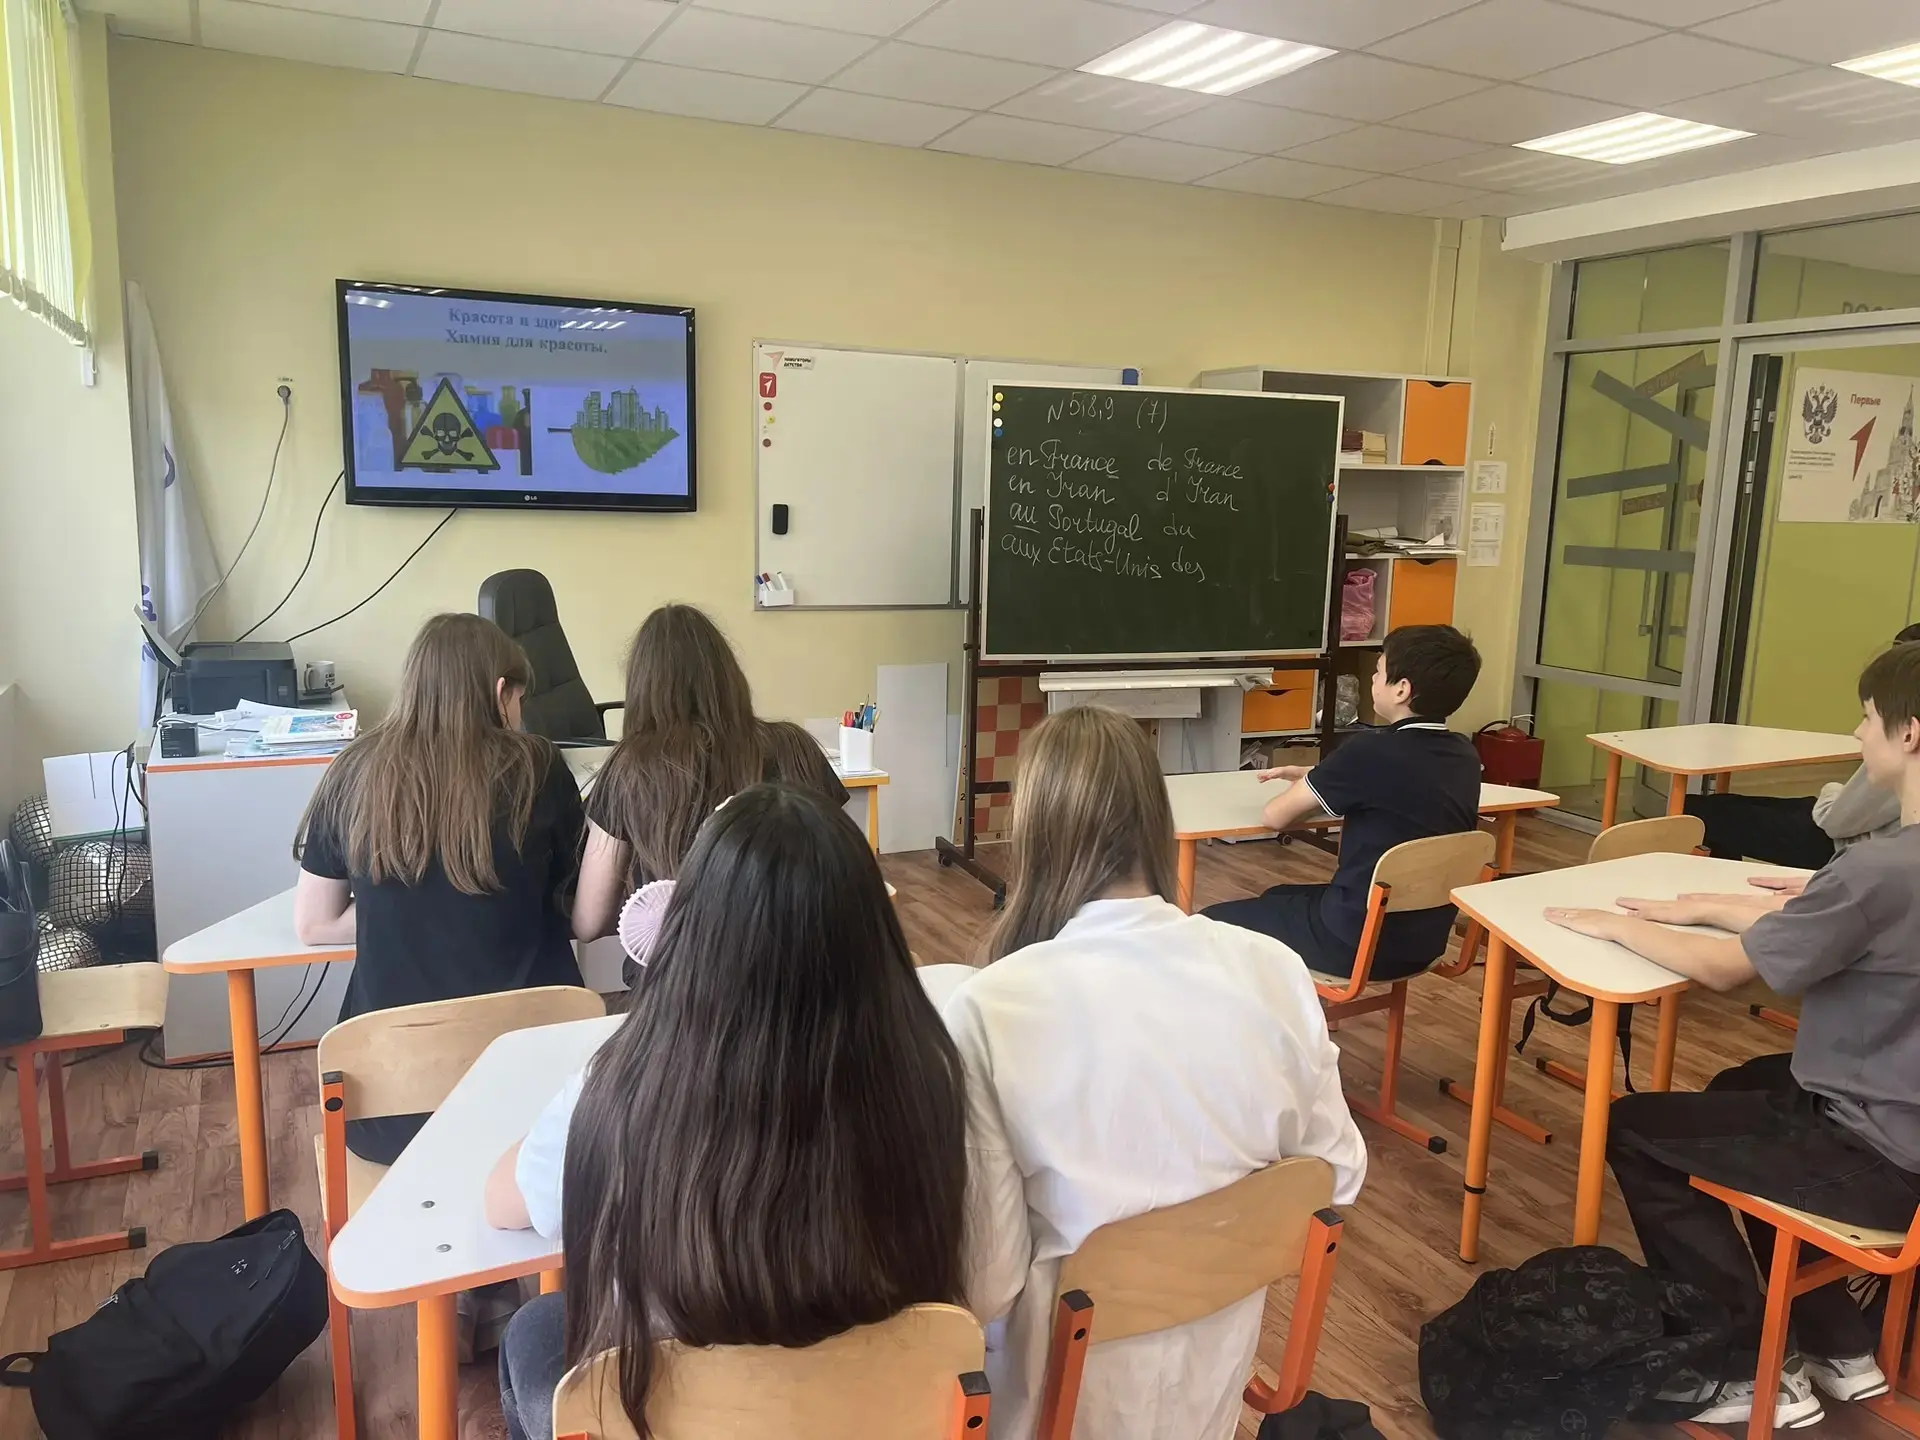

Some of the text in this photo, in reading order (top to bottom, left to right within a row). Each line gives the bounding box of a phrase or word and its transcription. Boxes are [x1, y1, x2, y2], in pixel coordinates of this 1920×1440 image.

[448, 308, 514, 326] Красота
[520, 316, 529, 327] и
[445, 329, 608, 353] Химия для красоты.
[1850, 393, 1881, 408] Первые
[1137, 398, 1167, 433] (7)
[1008, 439, 1243, 479] en France de France
[1009, 475, 1035, 494] en
[1010, 503, 1196, 554] au Portugal du
[1001, 534, 1040, 567] aux
[1172, 546, 1205, 583] des
